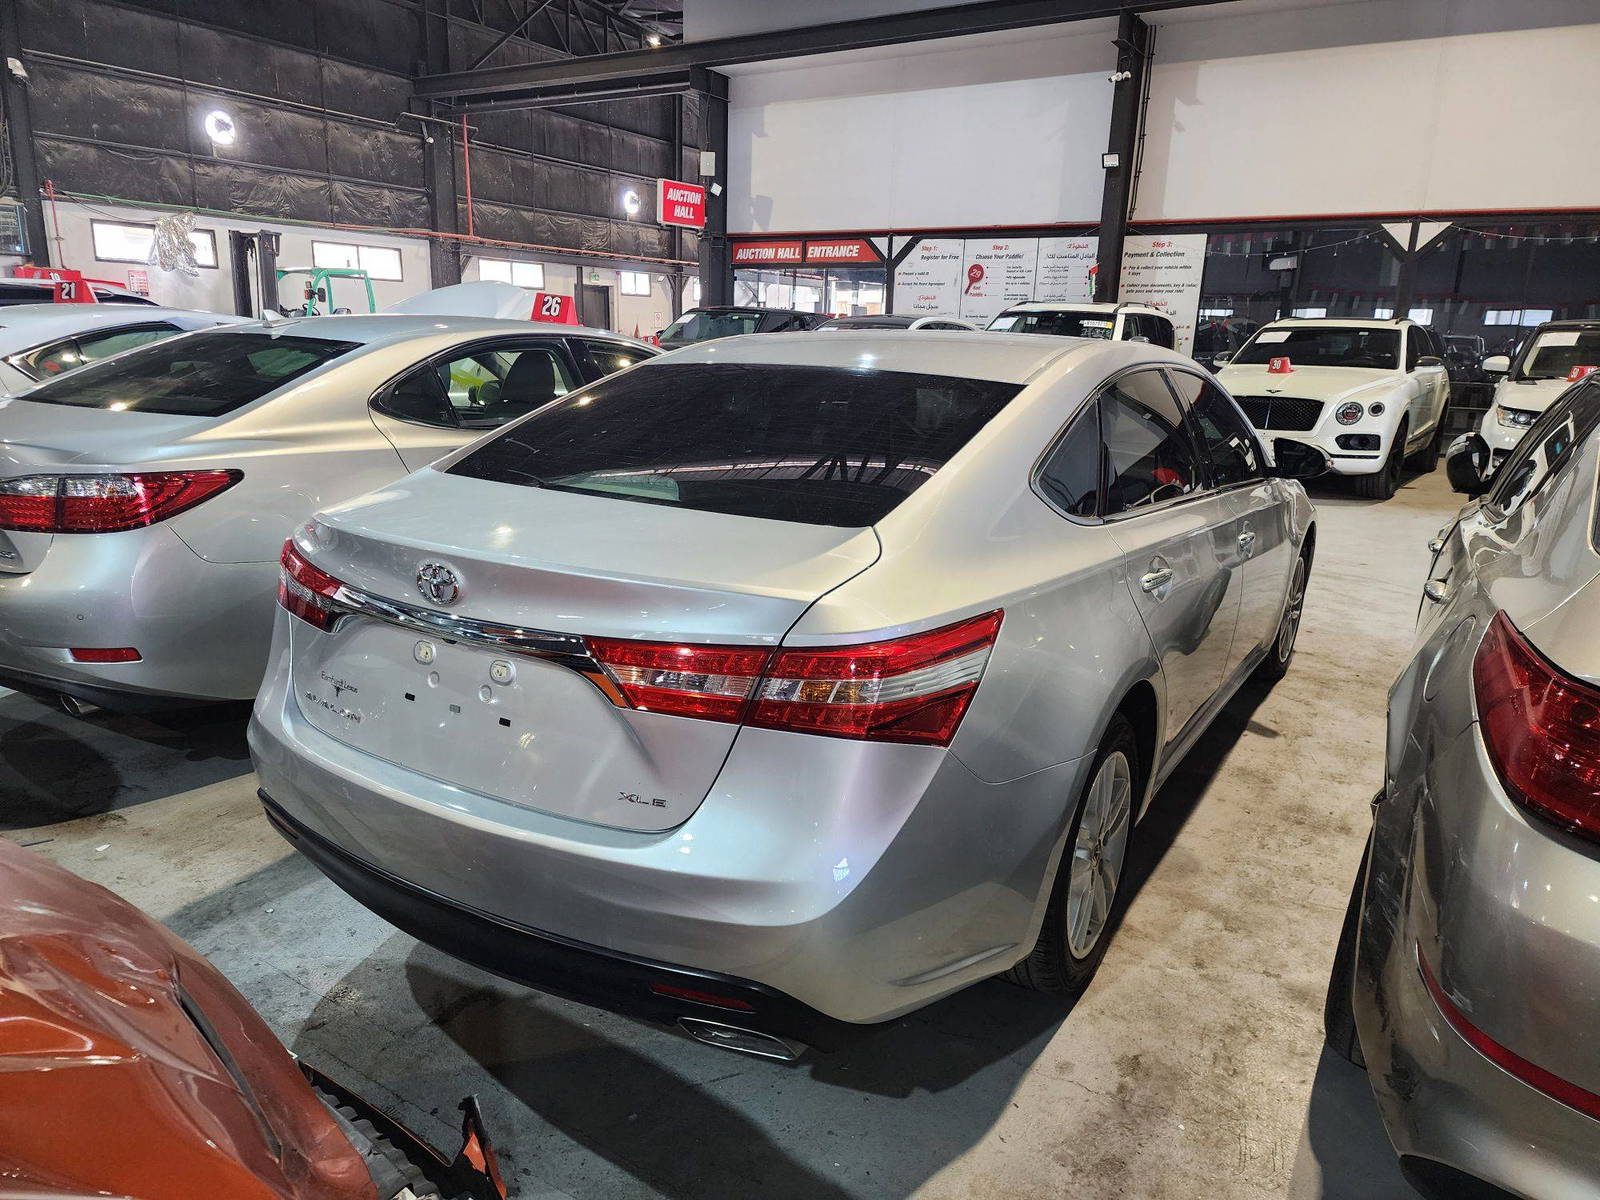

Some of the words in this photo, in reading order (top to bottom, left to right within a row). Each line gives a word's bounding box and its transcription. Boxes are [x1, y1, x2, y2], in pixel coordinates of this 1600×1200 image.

[667, 188, 701, 205] AUCTION
[674, 205, 694, 219] HALL
[736, 248, 775, 259] AUCTION
[777, 247, 800, 259] HALL
[807, 245, 860, 258] ENTRANCE
[970, 268, 982, 279] 29
[61, 282, 76, 299] 21
[542, 295, 561, 317] 26
[618, 791, 667, 808] XLE
